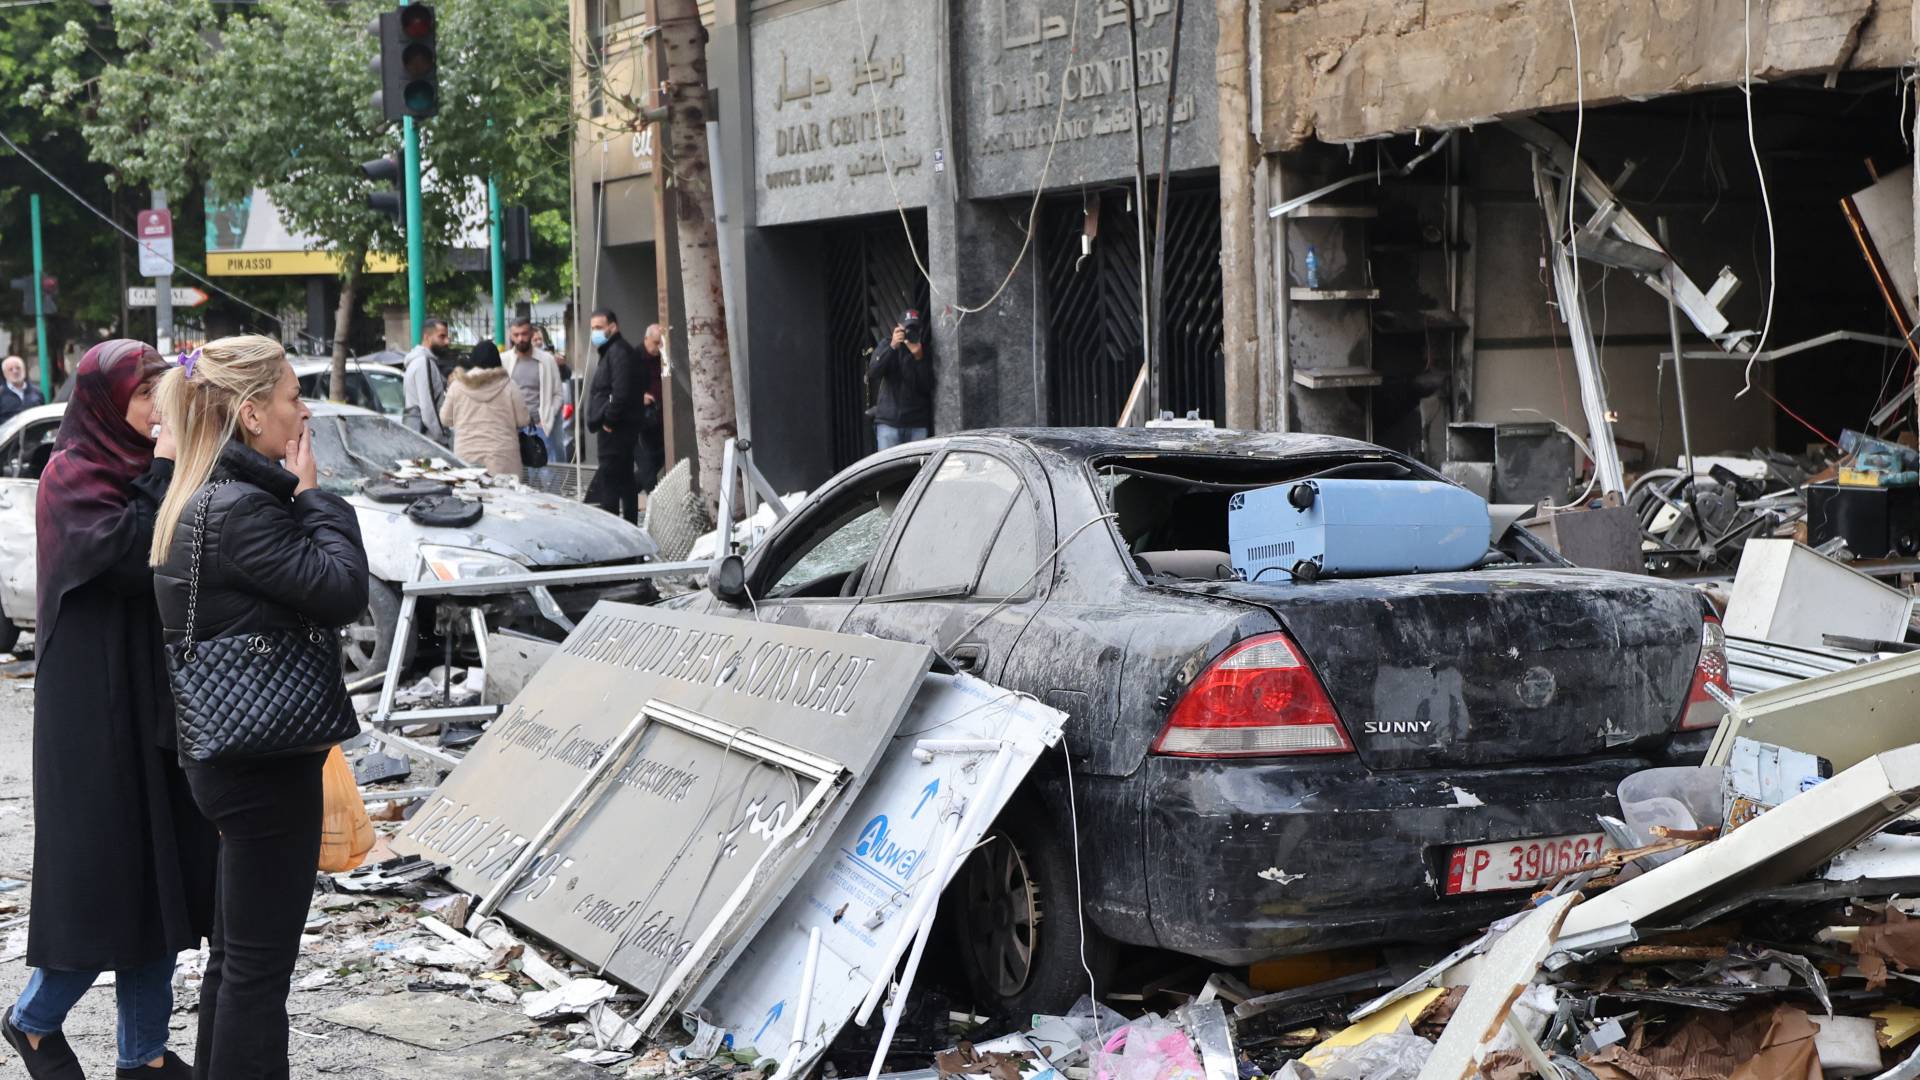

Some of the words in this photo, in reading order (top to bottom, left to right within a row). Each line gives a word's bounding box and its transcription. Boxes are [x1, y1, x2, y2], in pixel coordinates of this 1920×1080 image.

[1062, 47, 1170, 101] CENTER
[775, 122, 822, 158] DIAR
[827, 106, 907, 148] CENTER
[227, 258, 272, 271] PIKASSO
[564, 615, 681, 672] MAHMOUD
[659, 629, 735, 685] FAHS
[733, 640, 814, 704] SONS
[792, 650, 876, 717] SARL
[1364, 720, 1432, 734] SUNNY
[856, 814, 927, 881] Aluwell
[1471, 850, 1491, 886] P
